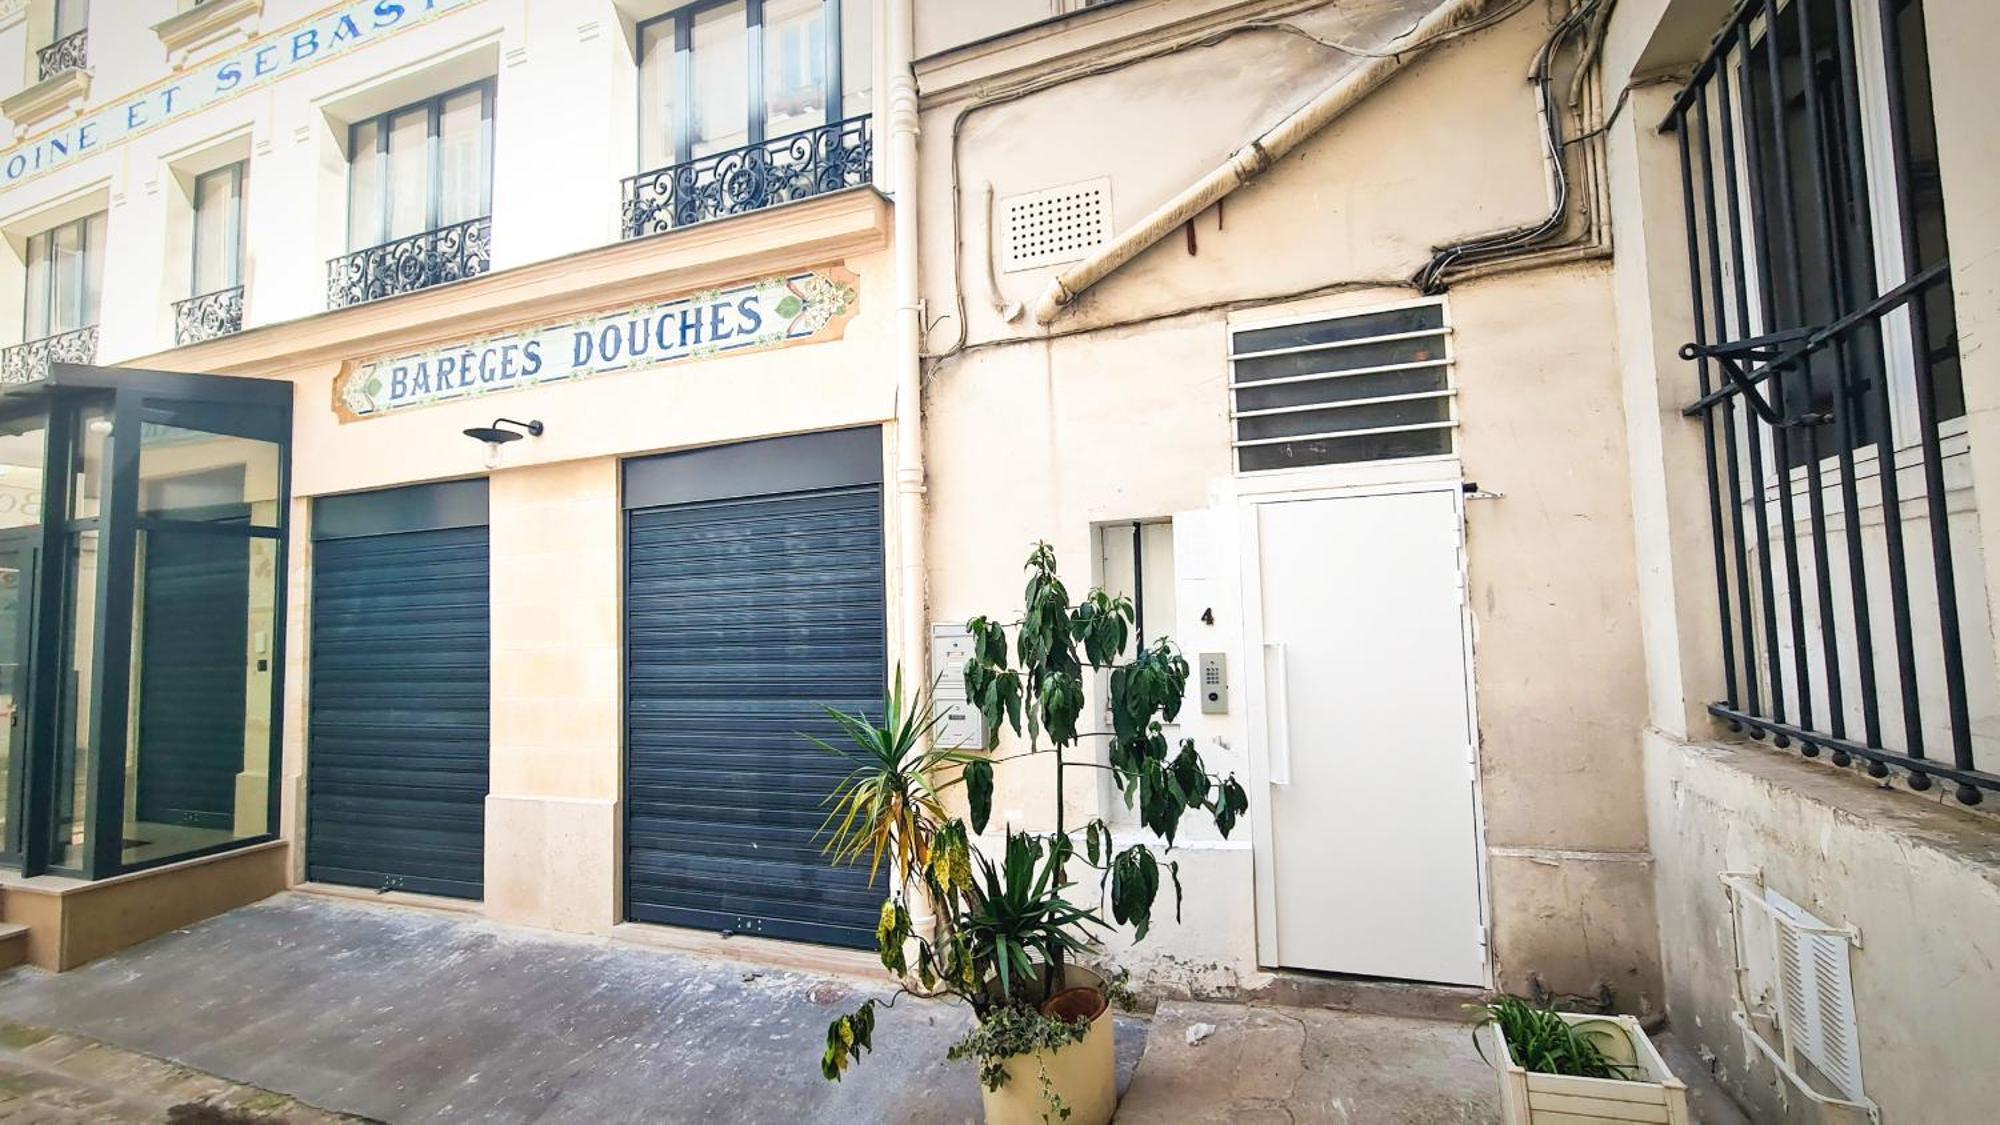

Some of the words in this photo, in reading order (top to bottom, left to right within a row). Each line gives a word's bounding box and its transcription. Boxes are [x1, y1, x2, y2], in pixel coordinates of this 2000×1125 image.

[127, 86, 181, 129] ET
[571, 295, 762, 368] DOUCHES
[1201, 607, 1214, 626] 4
